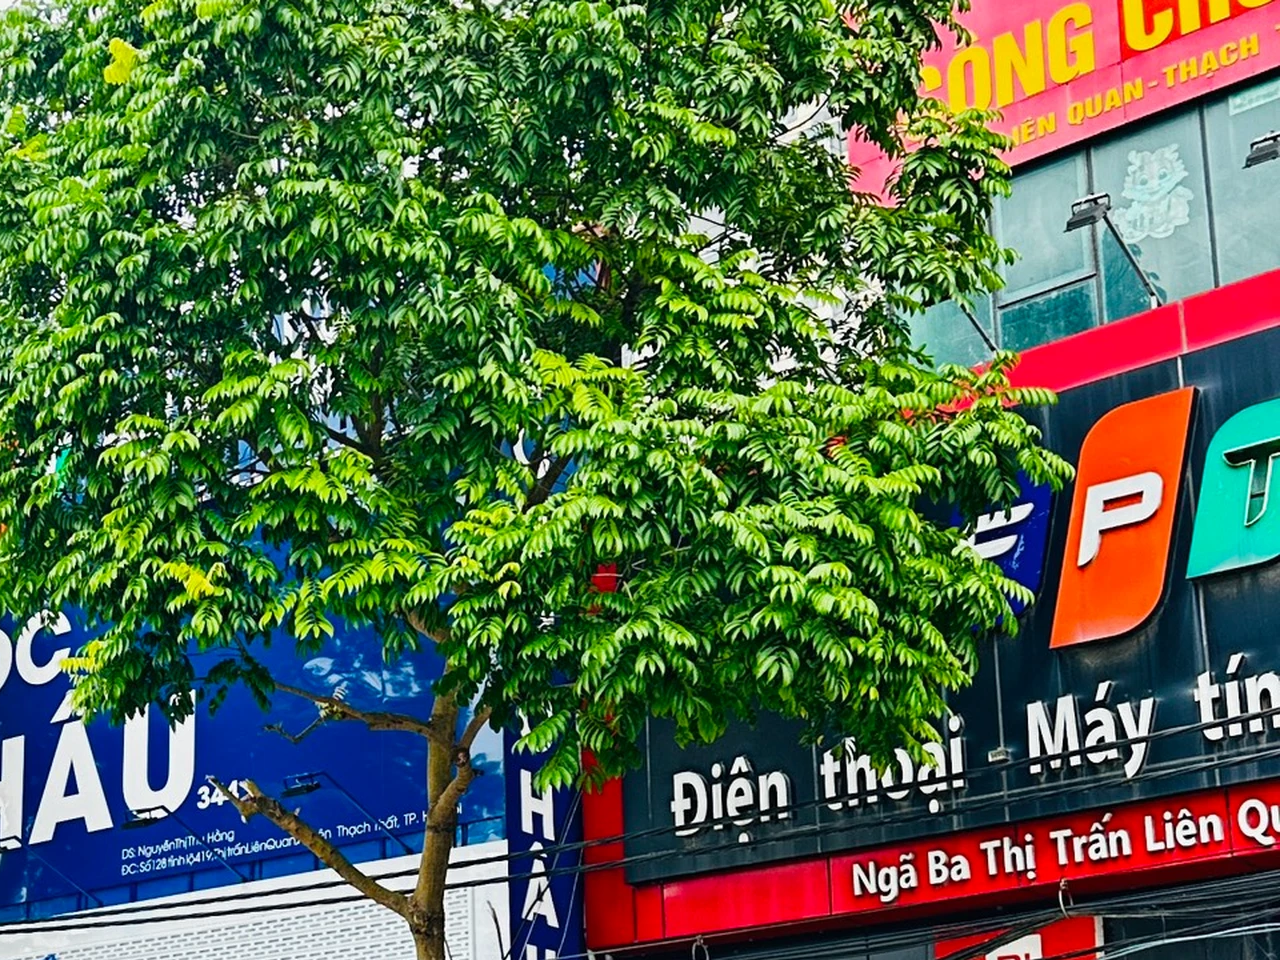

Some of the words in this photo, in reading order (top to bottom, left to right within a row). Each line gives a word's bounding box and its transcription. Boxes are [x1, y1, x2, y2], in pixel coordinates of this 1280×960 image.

[920, 3, 1097, 115] ÔNG
[1067, 78, 1145, 127] QUAN
[1162, 36, 1261, 88] THẠCH
[670, 756, 790, 843] Điện
[820, 714, 965, 814] thoại
[1026, 680, 1155, 779] Máy
[336, 822, 371, 838] Thạch
[851, 852, 919, 903] Ngã
[928, 849, 971, 886] Ba
[980, 833, 1036, 880] Thị
[1049, 812, 1132, 866] Trấn
[1144, 808, 1225, 853] Liên
